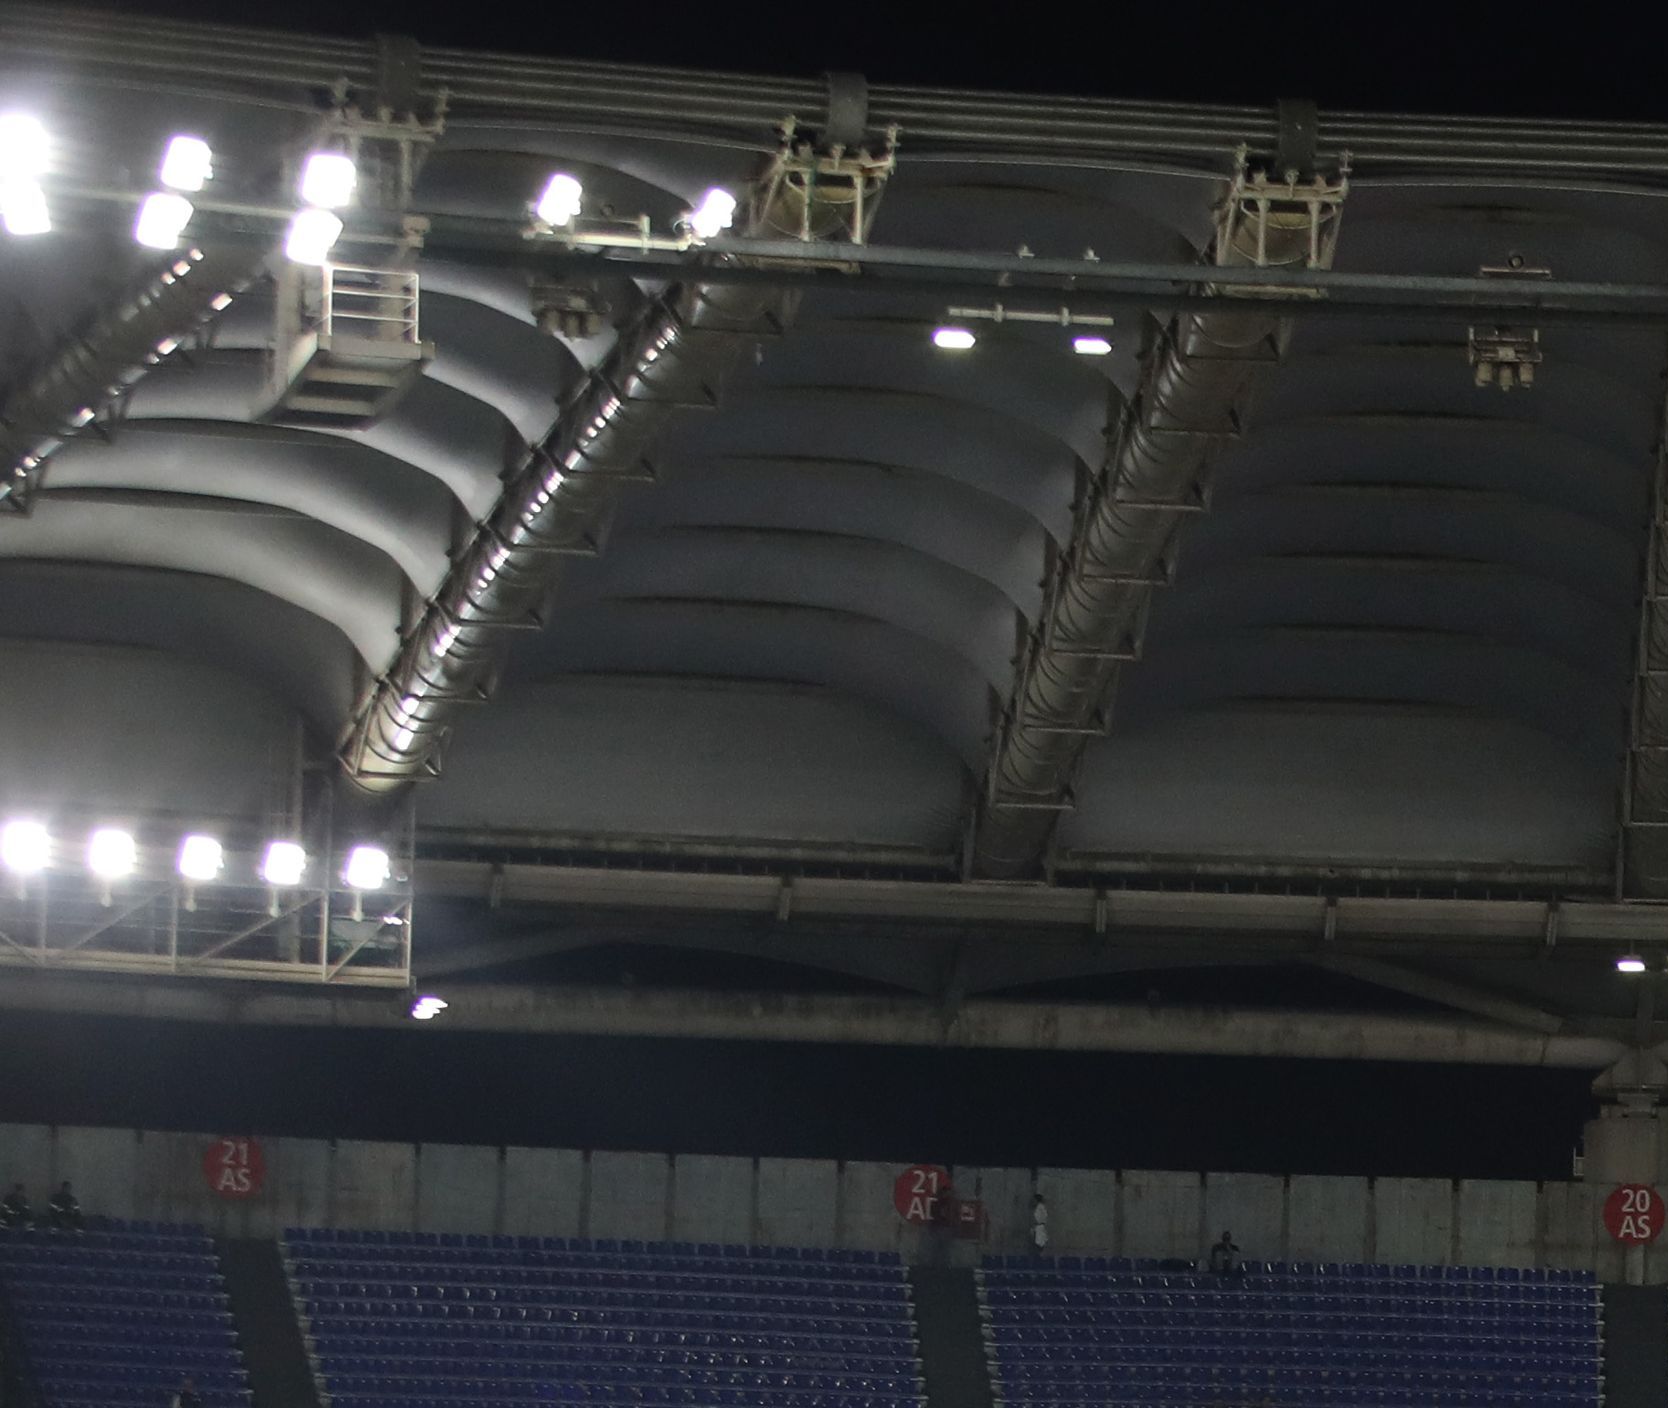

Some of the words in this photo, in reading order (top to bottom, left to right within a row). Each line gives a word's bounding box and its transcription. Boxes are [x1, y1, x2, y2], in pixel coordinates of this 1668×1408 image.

[222, 1141, 249, 1165] 21
[218, 1168, 251, 1192] AS
[911, 1170, 938, 1194] 21
[1621, 1189, 1650, 1213] 20
[1619, 1216, 1650, 1238] AS
